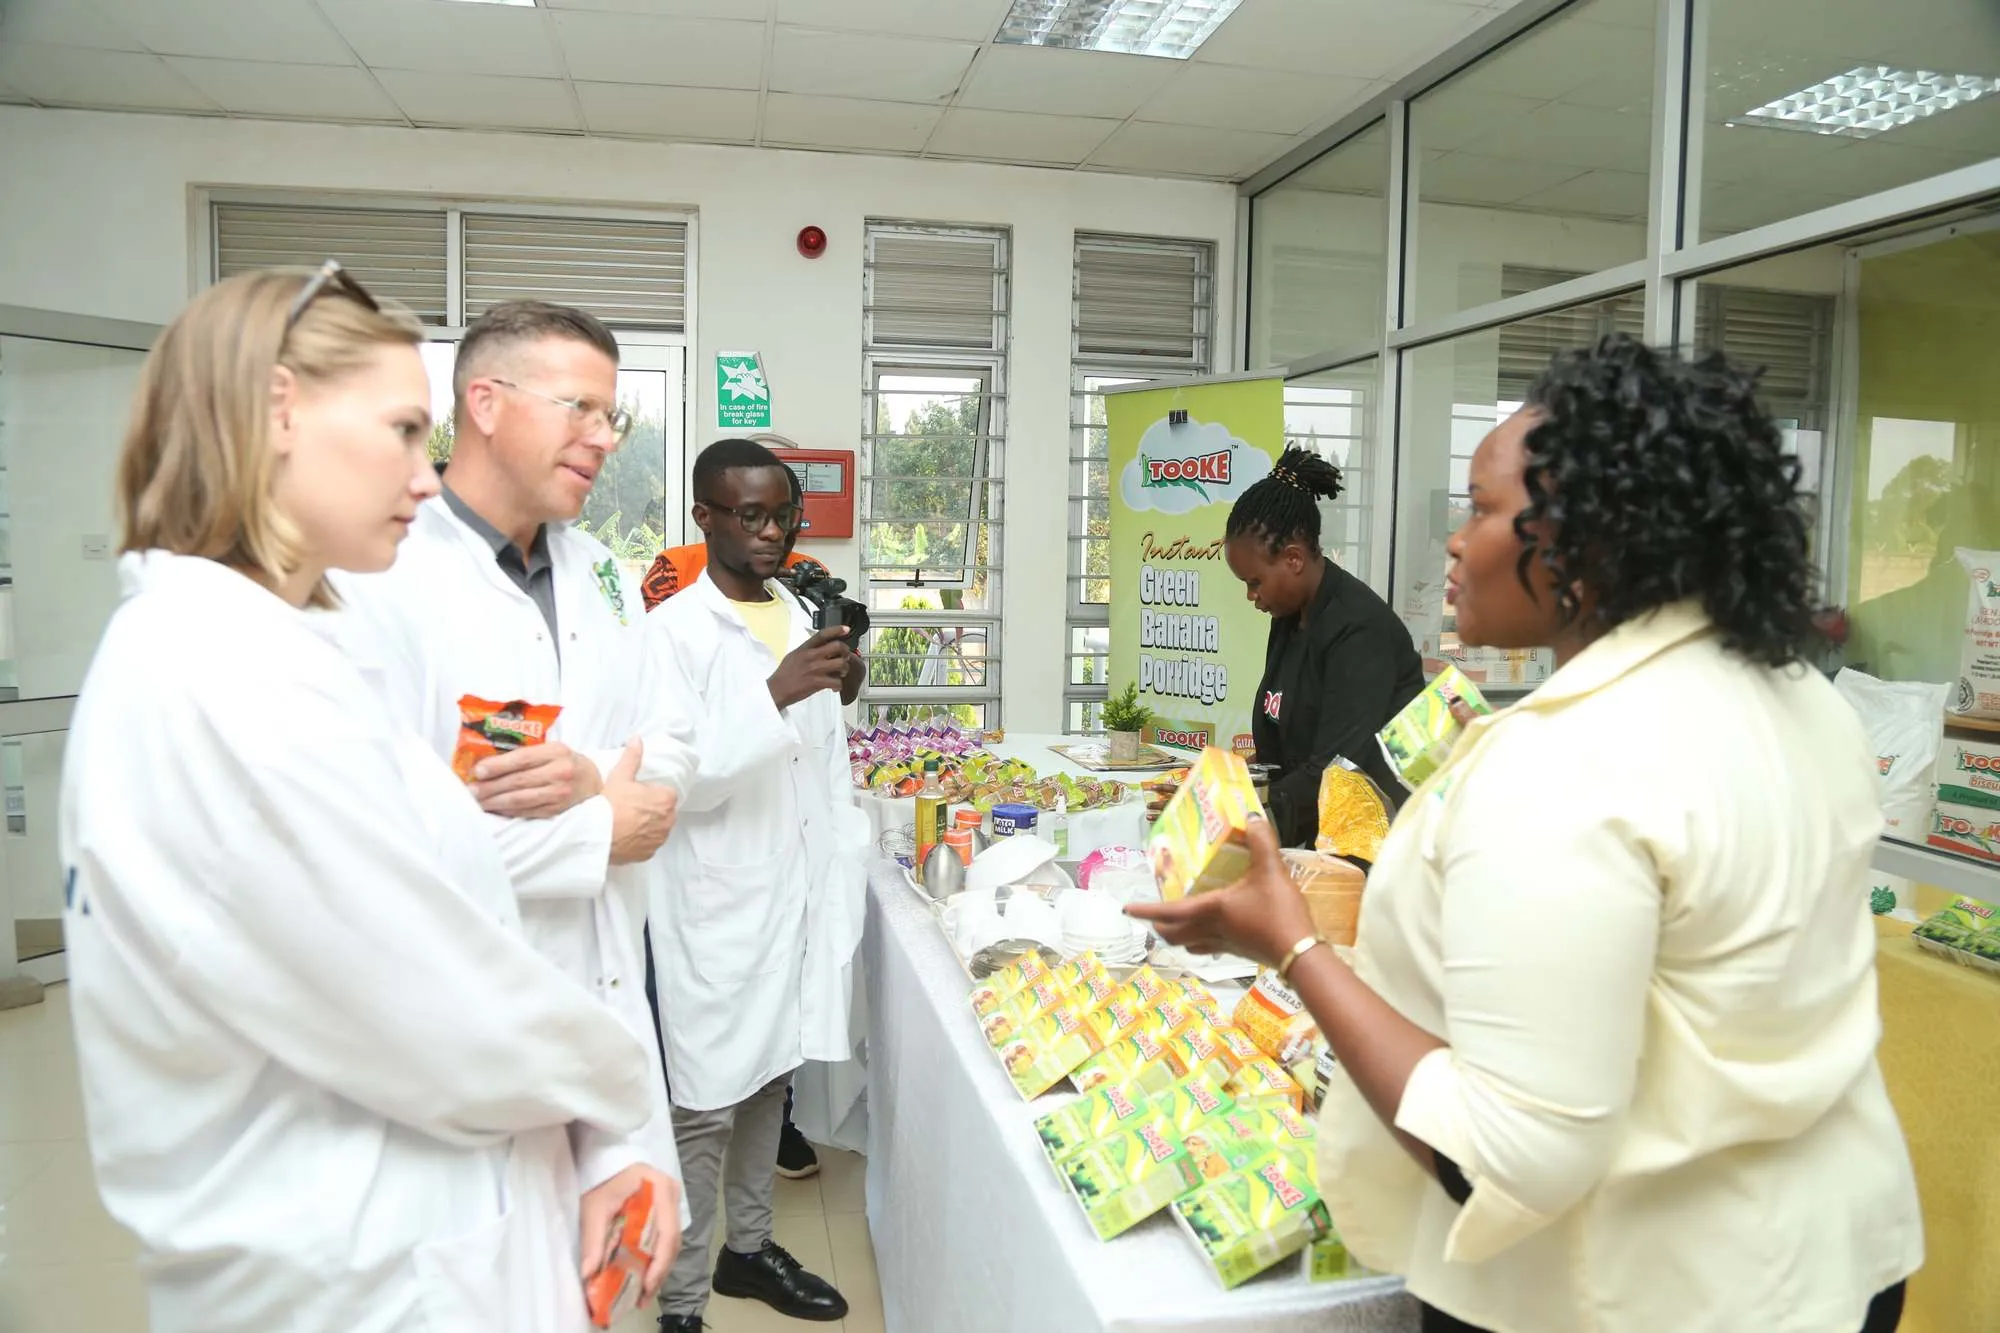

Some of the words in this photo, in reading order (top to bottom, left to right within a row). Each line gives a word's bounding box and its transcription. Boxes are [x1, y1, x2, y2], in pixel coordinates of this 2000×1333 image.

[744, 418, 757, 426] key
[1148, 450, 1231, 483] TOOKE
[1141, 530, 1225, 562] Instant
[1140, 564, 1200, 607] Green
[1140, 607, 1219, 653] Banana
[1139, 653, 1228, 705] Porridge
[491, 716, 543, 739] TOOKE
[1157, 729, 1208, 750] TOOKE
[994, 826, 1014, 835] MILK
[1953, 902, 1995, 919] TOOKE
[1139, 1123, 1175, 1163] TOOKE
[1262, 1164, 1306, 1209] TOOKE
